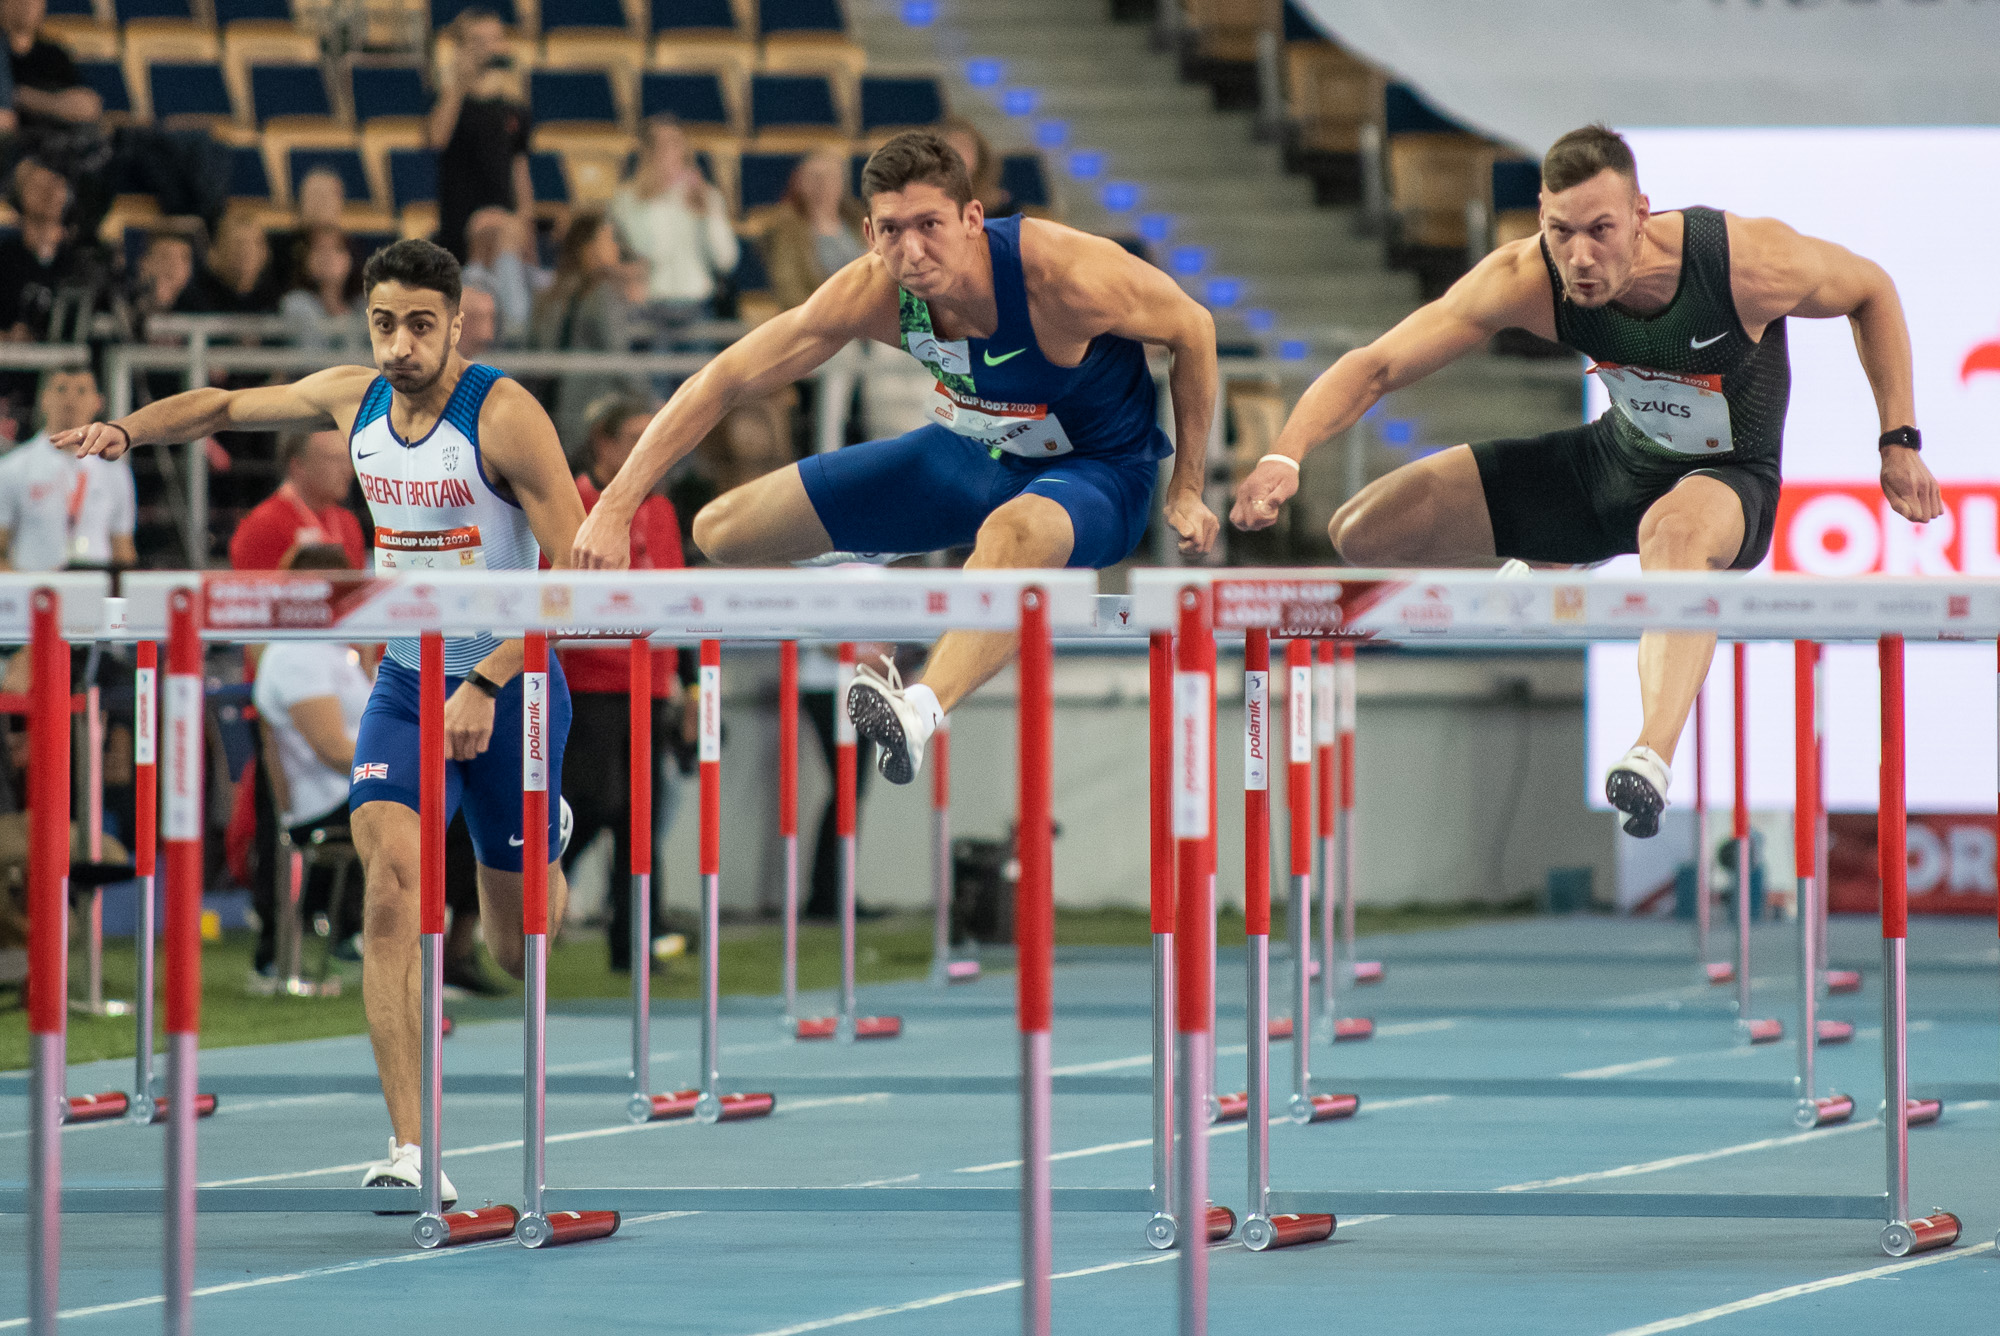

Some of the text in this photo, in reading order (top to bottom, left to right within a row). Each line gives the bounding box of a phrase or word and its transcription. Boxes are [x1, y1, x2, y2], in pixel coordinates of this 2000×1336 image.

[1684, 376, 1711, 389] 2020
[1011, 403, 1037, 414] 2020
[1630, 398, 1691, 418] SZUCS
[359, 471, 476, 508] GREAT BRITAIN
[379, 533, 401, 546] ORLEN
[401, 536, 418, 547] CUP
[445, 533, 470, 546] 2020
[527, 700, 543, 761] polanik
[1249, 699, 1264, 760] polanik
